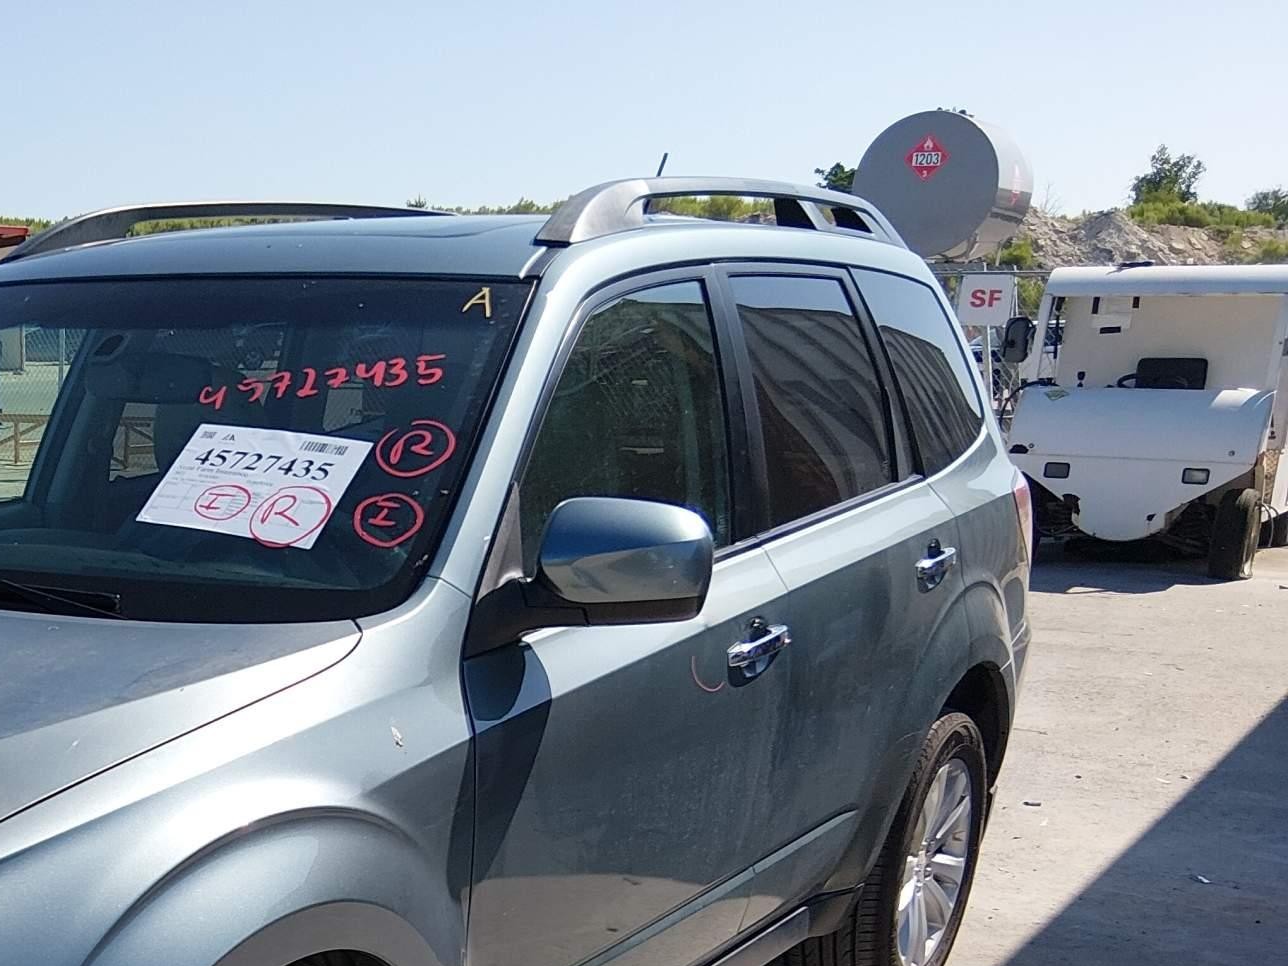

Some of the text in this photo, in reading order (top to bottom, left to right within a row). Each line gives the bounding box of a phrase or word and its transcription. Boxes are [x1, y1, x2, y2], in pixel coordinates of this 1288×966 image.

[914, 152, 940, 166] 1203
[462, 287, 492, 318] A
[970, 289, 1002, 307] SF
[194, 447, 335, 481] 45727435
